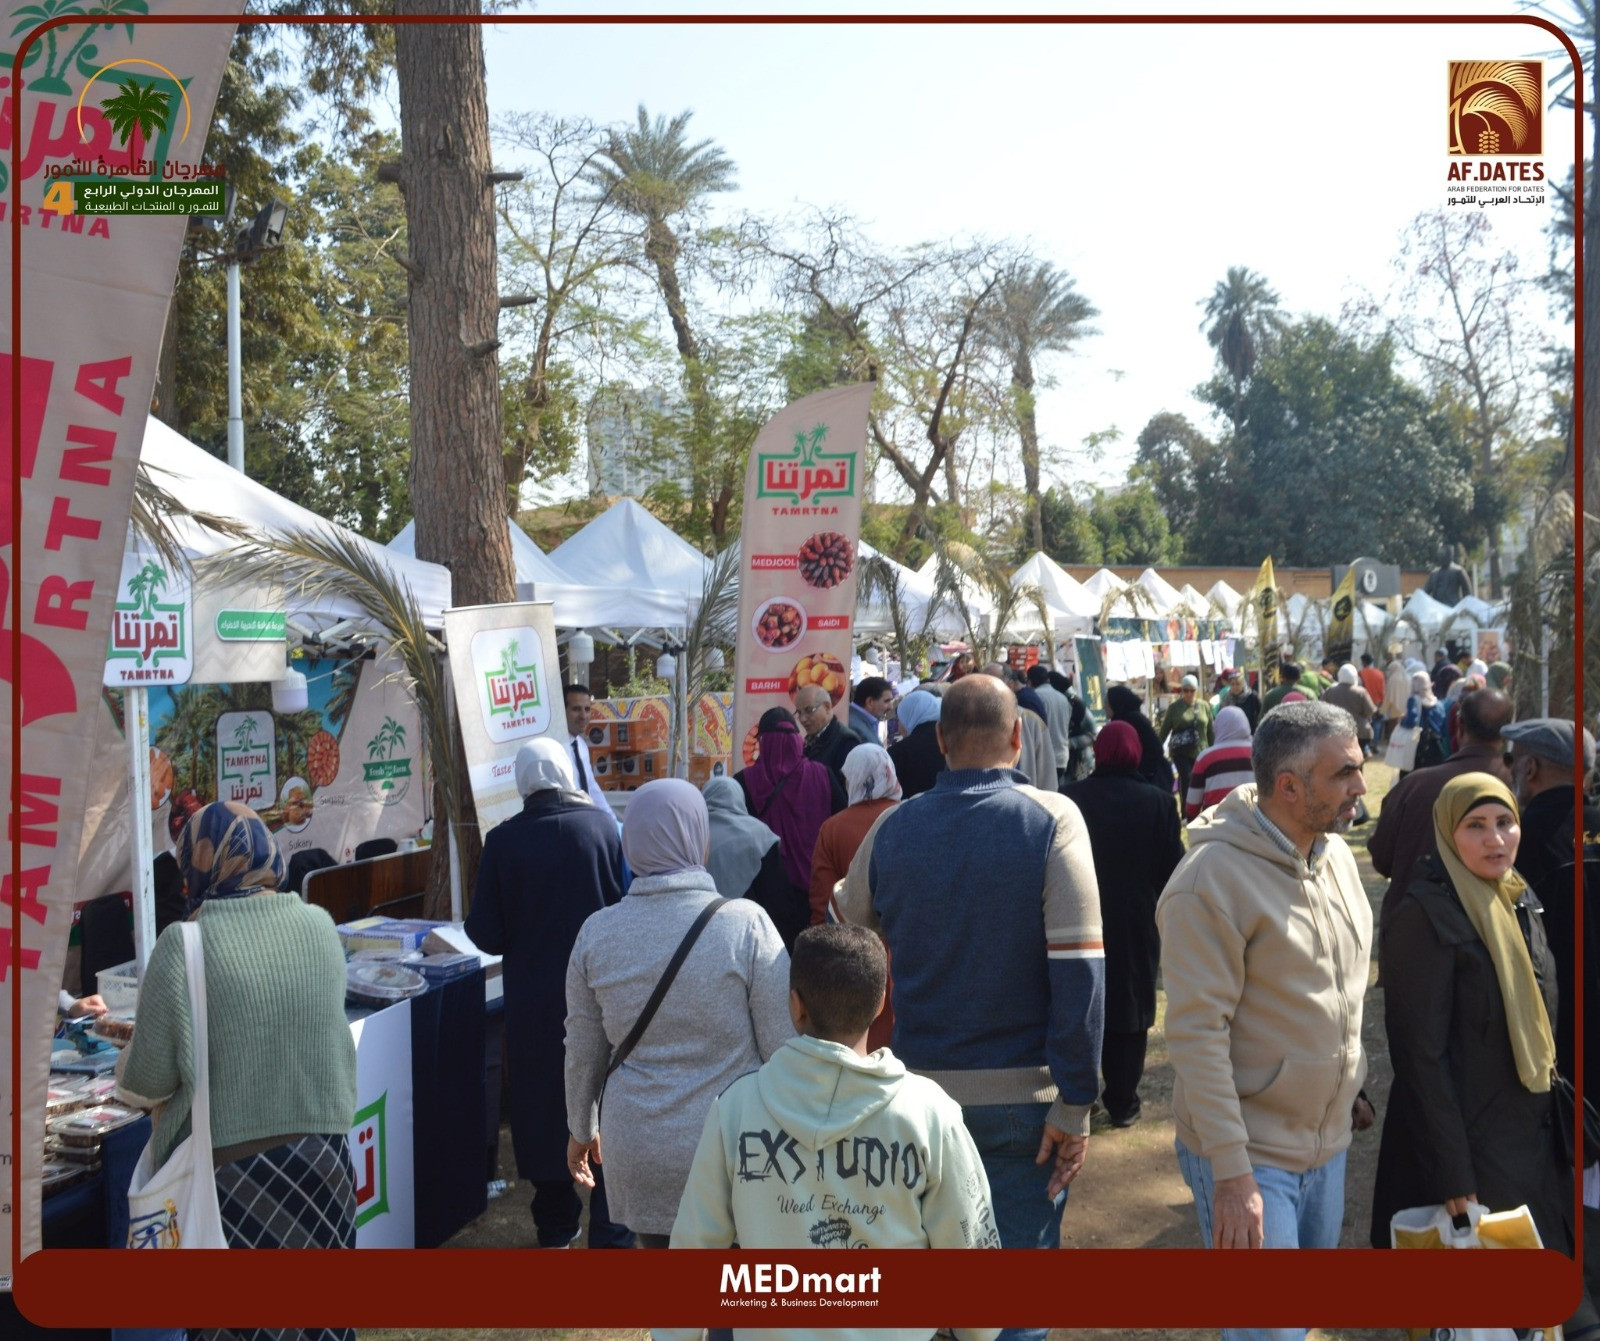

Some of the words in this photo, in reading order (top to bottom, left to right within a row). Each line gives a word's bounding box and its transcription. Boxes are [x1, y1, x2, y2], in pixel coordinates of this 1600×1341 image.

[766, 461, 846, 500] تمرتنا
[772, 507, 839, 516] TAMRTNA
[752, 558, 796, 567] MEDJOOL
[817, 618, 840, 628] SAIDI
[114, 611, 178, 661] تمرتنا
[120, 669, 174, 680] TAMRTNA
[751, 680, 781, 690] BARHI
[490, 673, 535, 712] تمرتنا
[502, 716, 536, 729] TAMRTNA
[225, 755, 267, 768] TAMRTNA
[491, 764, 512, 778] Taste
[231, 782, 263, 805] تمرتنا
[777, 1195, 815, 1215] Weed
[821, 1194, 886, 1225] Exchange
